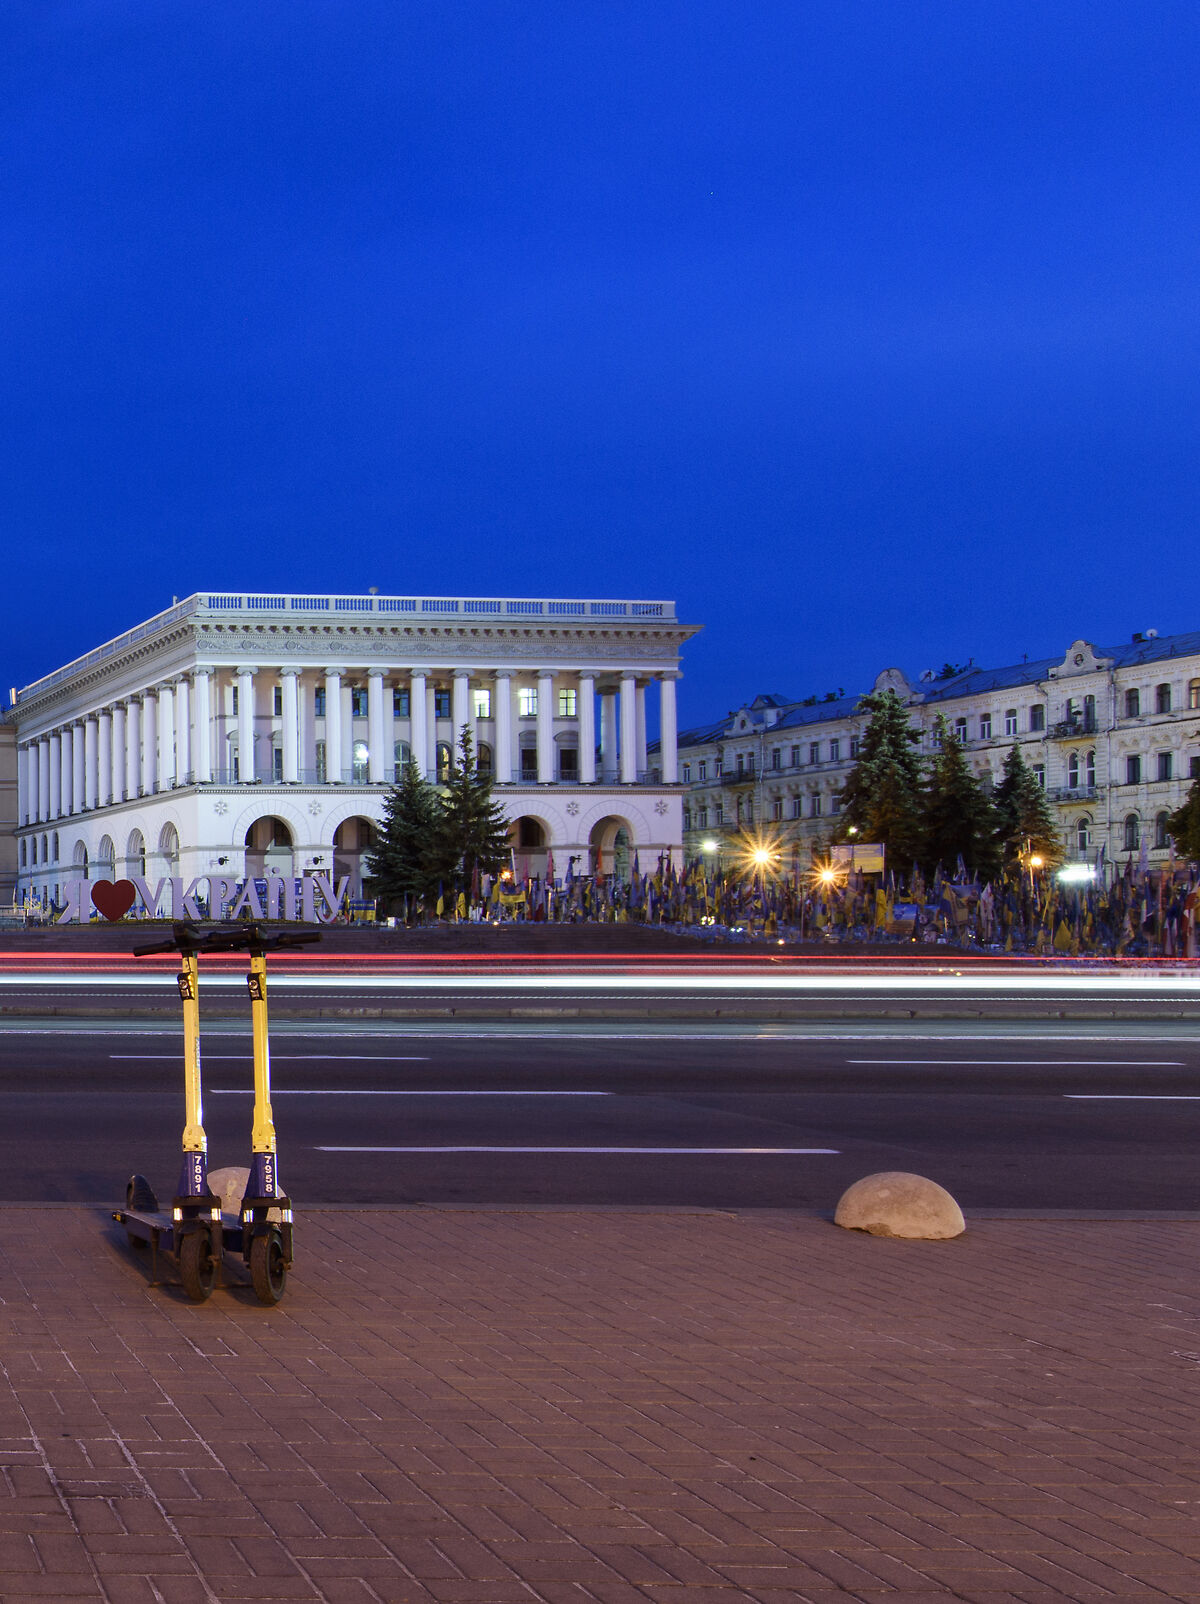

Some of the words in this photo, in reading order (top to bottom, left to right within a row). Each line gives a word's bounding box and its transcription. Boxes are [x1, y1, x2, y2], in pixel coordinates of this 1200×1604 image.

[57, 879, 92, 924] Я
[131, 867, 349, 923] УКРАЇНУ
[194, 1155, 202, 1193] 7891
[264, 1155, 273, 1193] 7958
